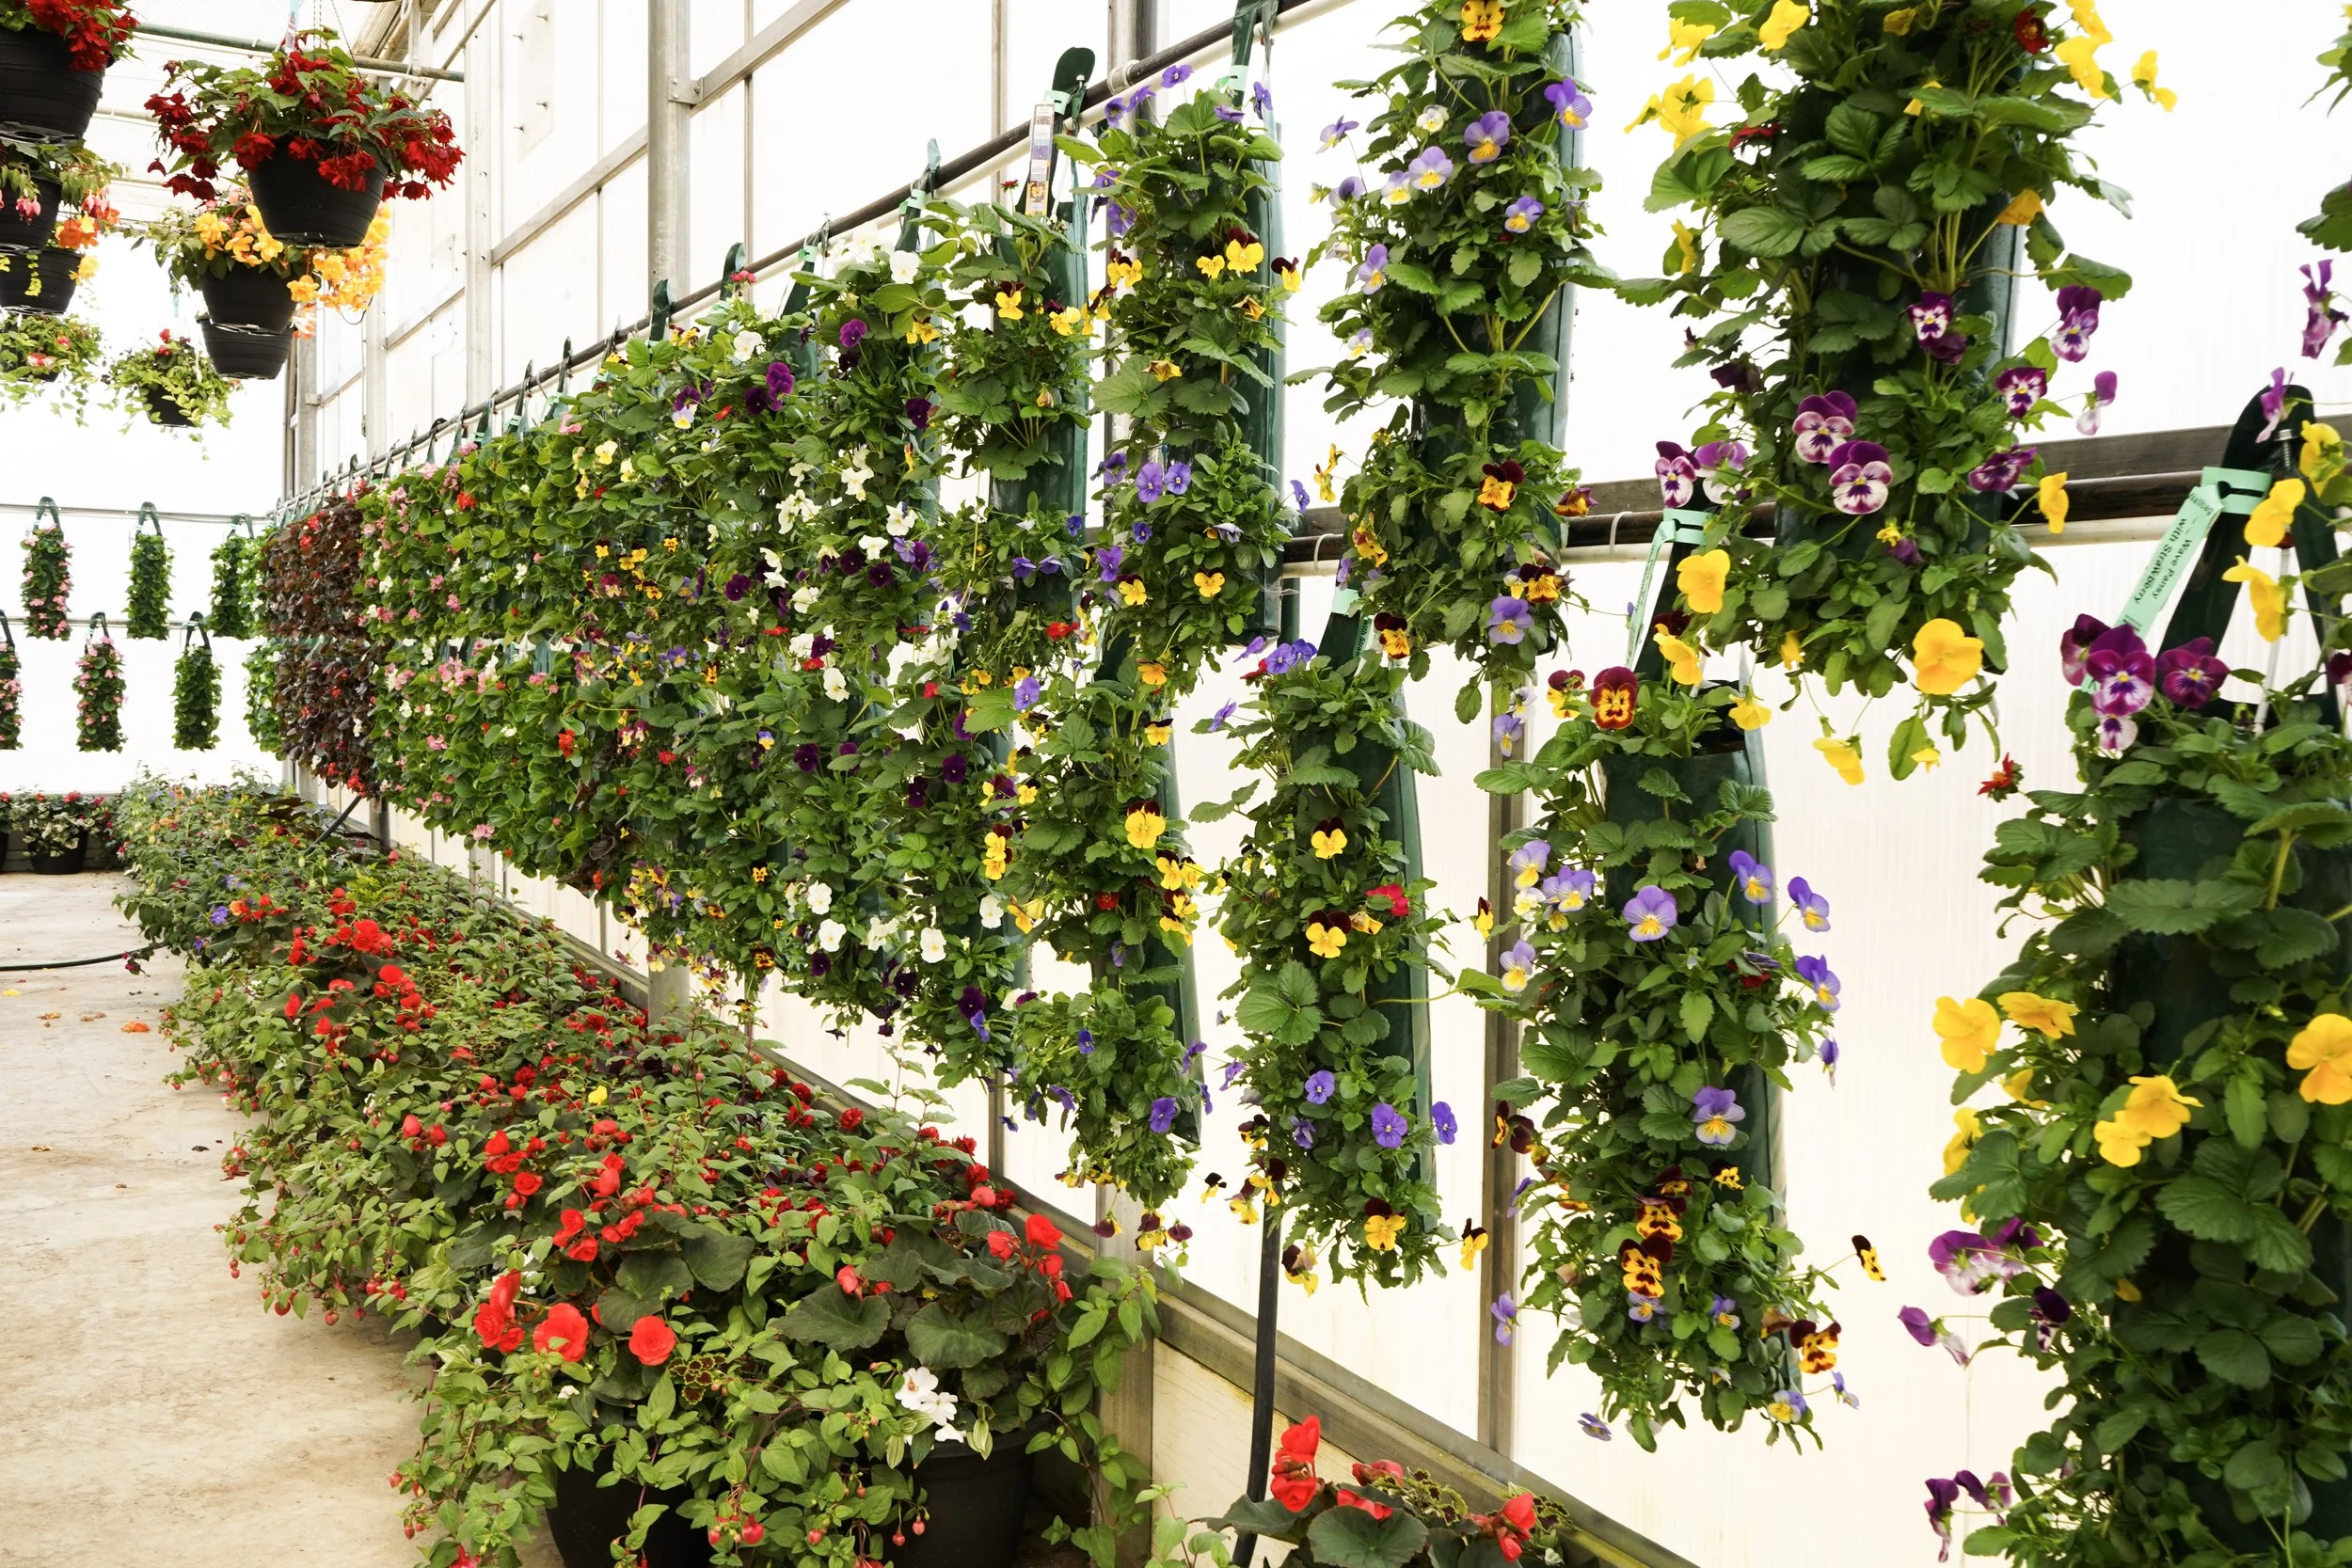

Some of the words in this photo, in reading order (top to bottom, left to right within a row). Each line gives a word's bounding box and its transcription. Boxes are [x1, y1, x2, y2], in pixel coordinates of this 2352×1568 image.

[2169, 518, 2187, 542] with
[2171, 539, 2192, 566] Wave
[2134, 544, 2172, 604] Strawberry
[2152, 568, 2174, 599] Pansy
[1360, 619, 1369, 636] with
[1355, 636, 1366, 659] Straw
